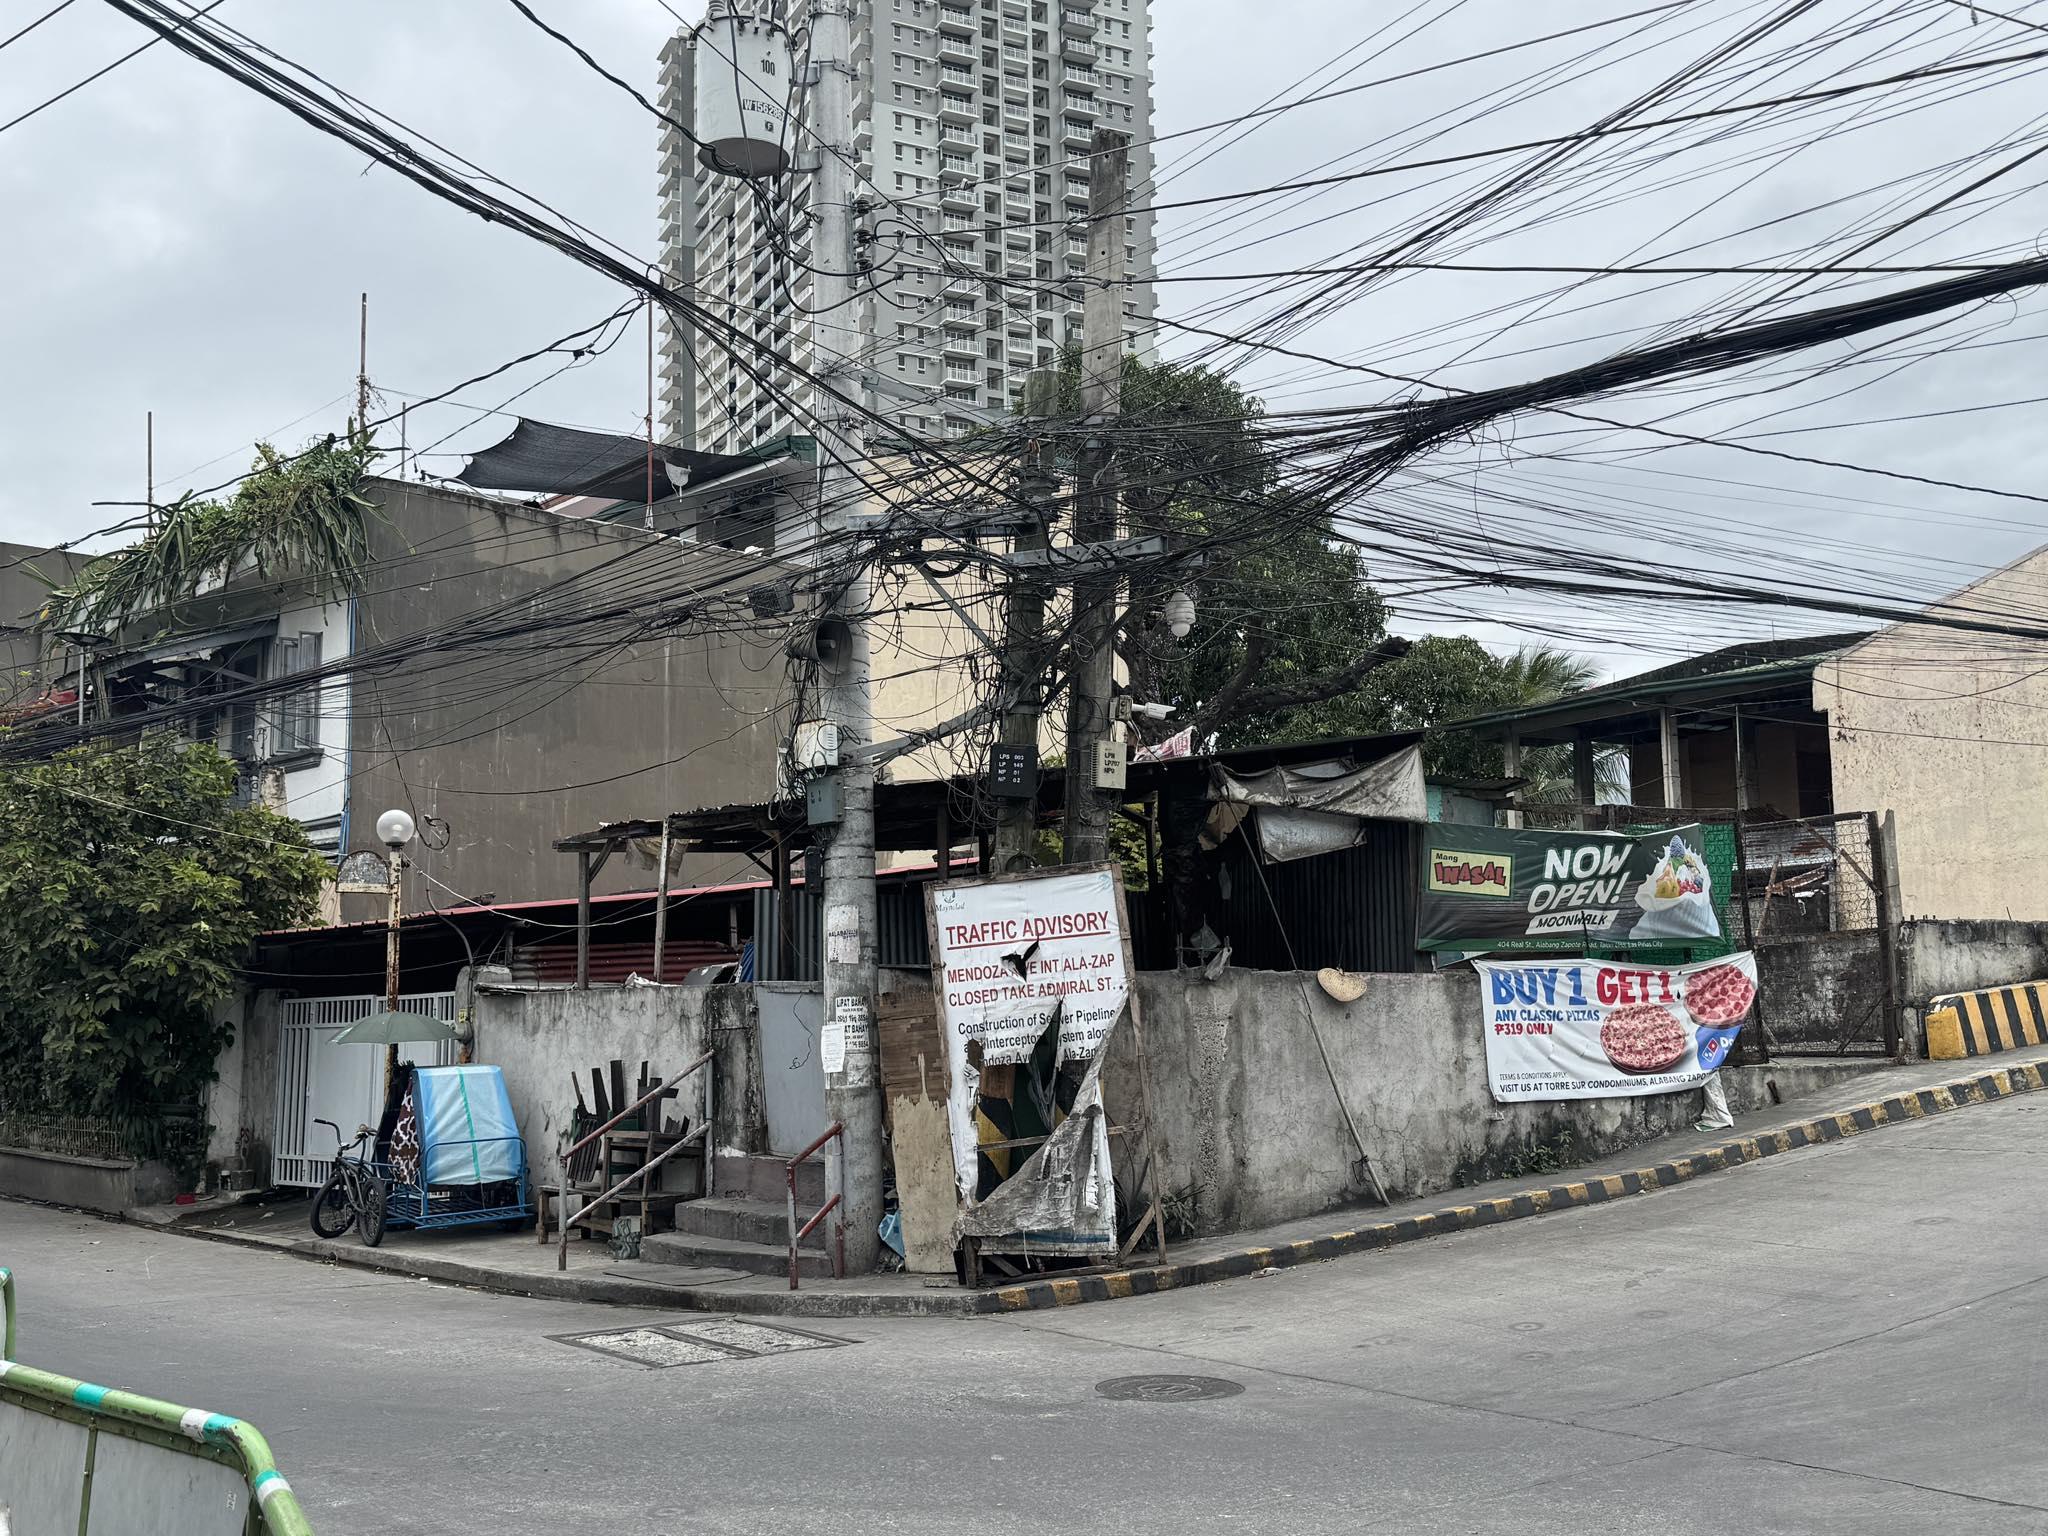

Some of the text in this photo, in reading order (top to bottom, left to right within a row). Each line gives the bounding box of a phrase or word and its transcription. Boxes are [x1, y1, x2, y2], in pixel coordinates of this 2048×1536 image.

[761, 60, 775, 76] 100
[1436, 853, 1458, 862] Mang
[1544, 844, 1633, 879] NOW
[1434, 862, 1506, 886] INASAL
[1527, 872, 1630, 913] OPEN!
[946, 911, 1108, 945] TRAFFIC ADVISORY
[1536, 914, 1608, 928] MOONWALK
[1536, 941, 1559, 949] Alabang
[947, 965, 1008, 983] MENDOZA
[1041, 959, 1059, 974] INT
[1064, 953, 1114, 971] ALA-ZAP
[949, 977, 1115, 1006] CLOSED TAKE ADMIRAL ST.
[1489, 967, 1559, 1005] BUY
[1565, 968, 1587, 1005] 1
[1597, 968, 1655, 1005] GET
[958, 1016, 1024, 1034] Construction
[1027, 1014, 1037, 1026] of
[1496, 1010, 1600, 1021] ANY CLASSIC PIZZAS
[1526, 1023, 1553, 1035] ONLY
[1500, 1083, 1518, 1092] VISIT
[1521, 1083, 1531, 1092] US
[1533, 1083, 1543, 1091] AT
[1545, 1081, 1570, 1090] TORRE
[1572, 1081, 1586, 1089] SUR
[1650, 1075, 1686, 1085] ALABANG
[1521, 1072, 1552, 1080] CONDITIONS
